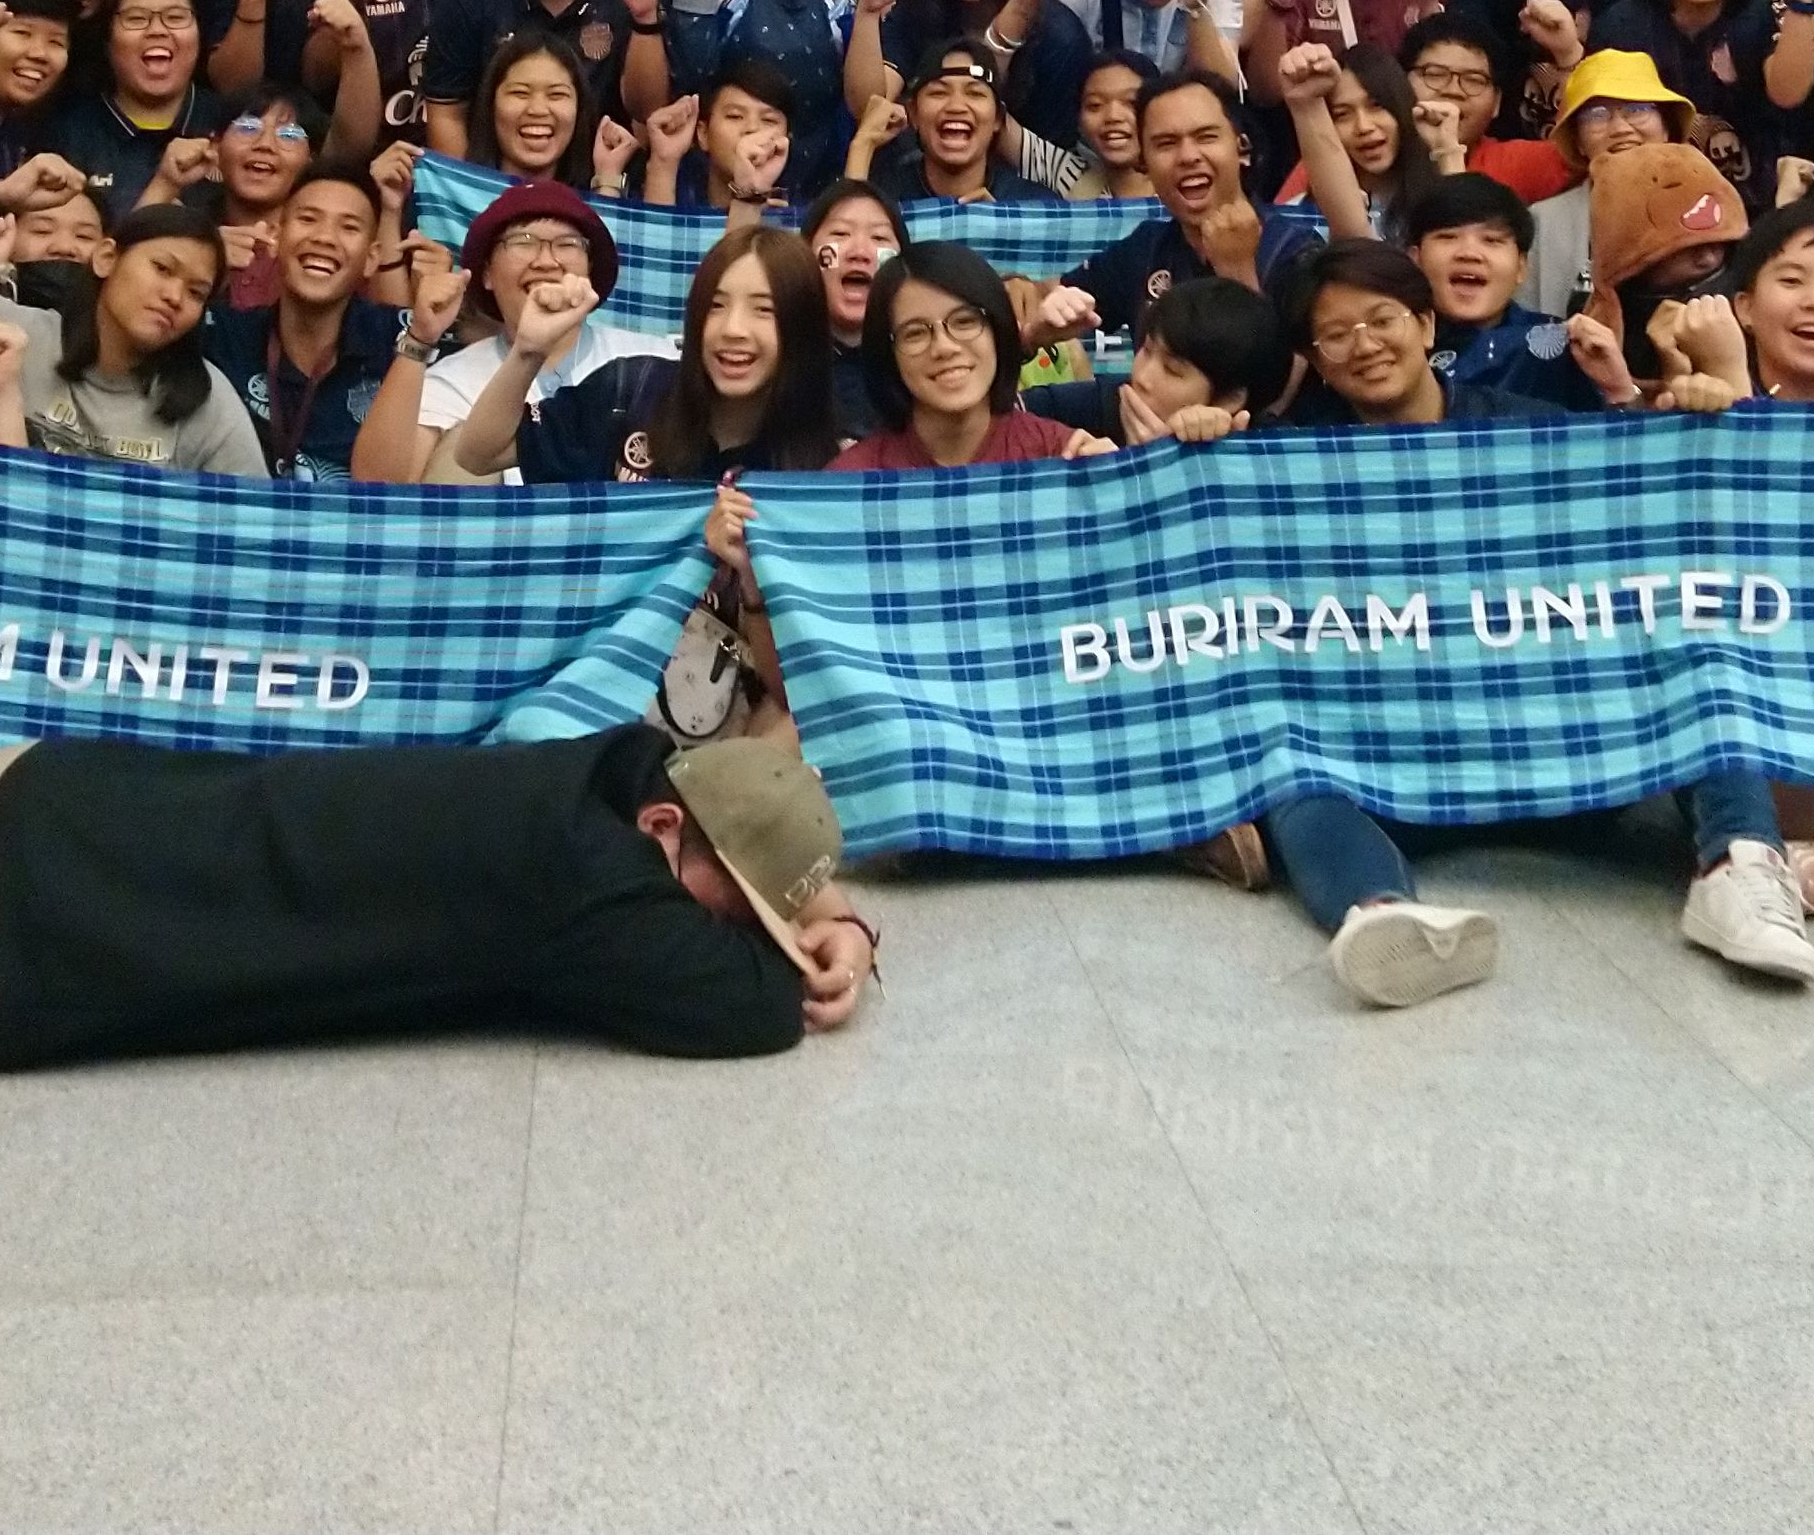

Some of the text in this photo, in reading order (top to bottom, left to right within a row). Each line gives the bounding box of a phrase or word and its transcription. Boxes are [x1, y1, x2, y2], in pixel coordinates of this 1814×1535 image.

[365, 1, 406, 17] YAMAHA
[1059, 570, 1793, 684] BURIRAM UNITED
[45, 628, 371, 712] UNITED
